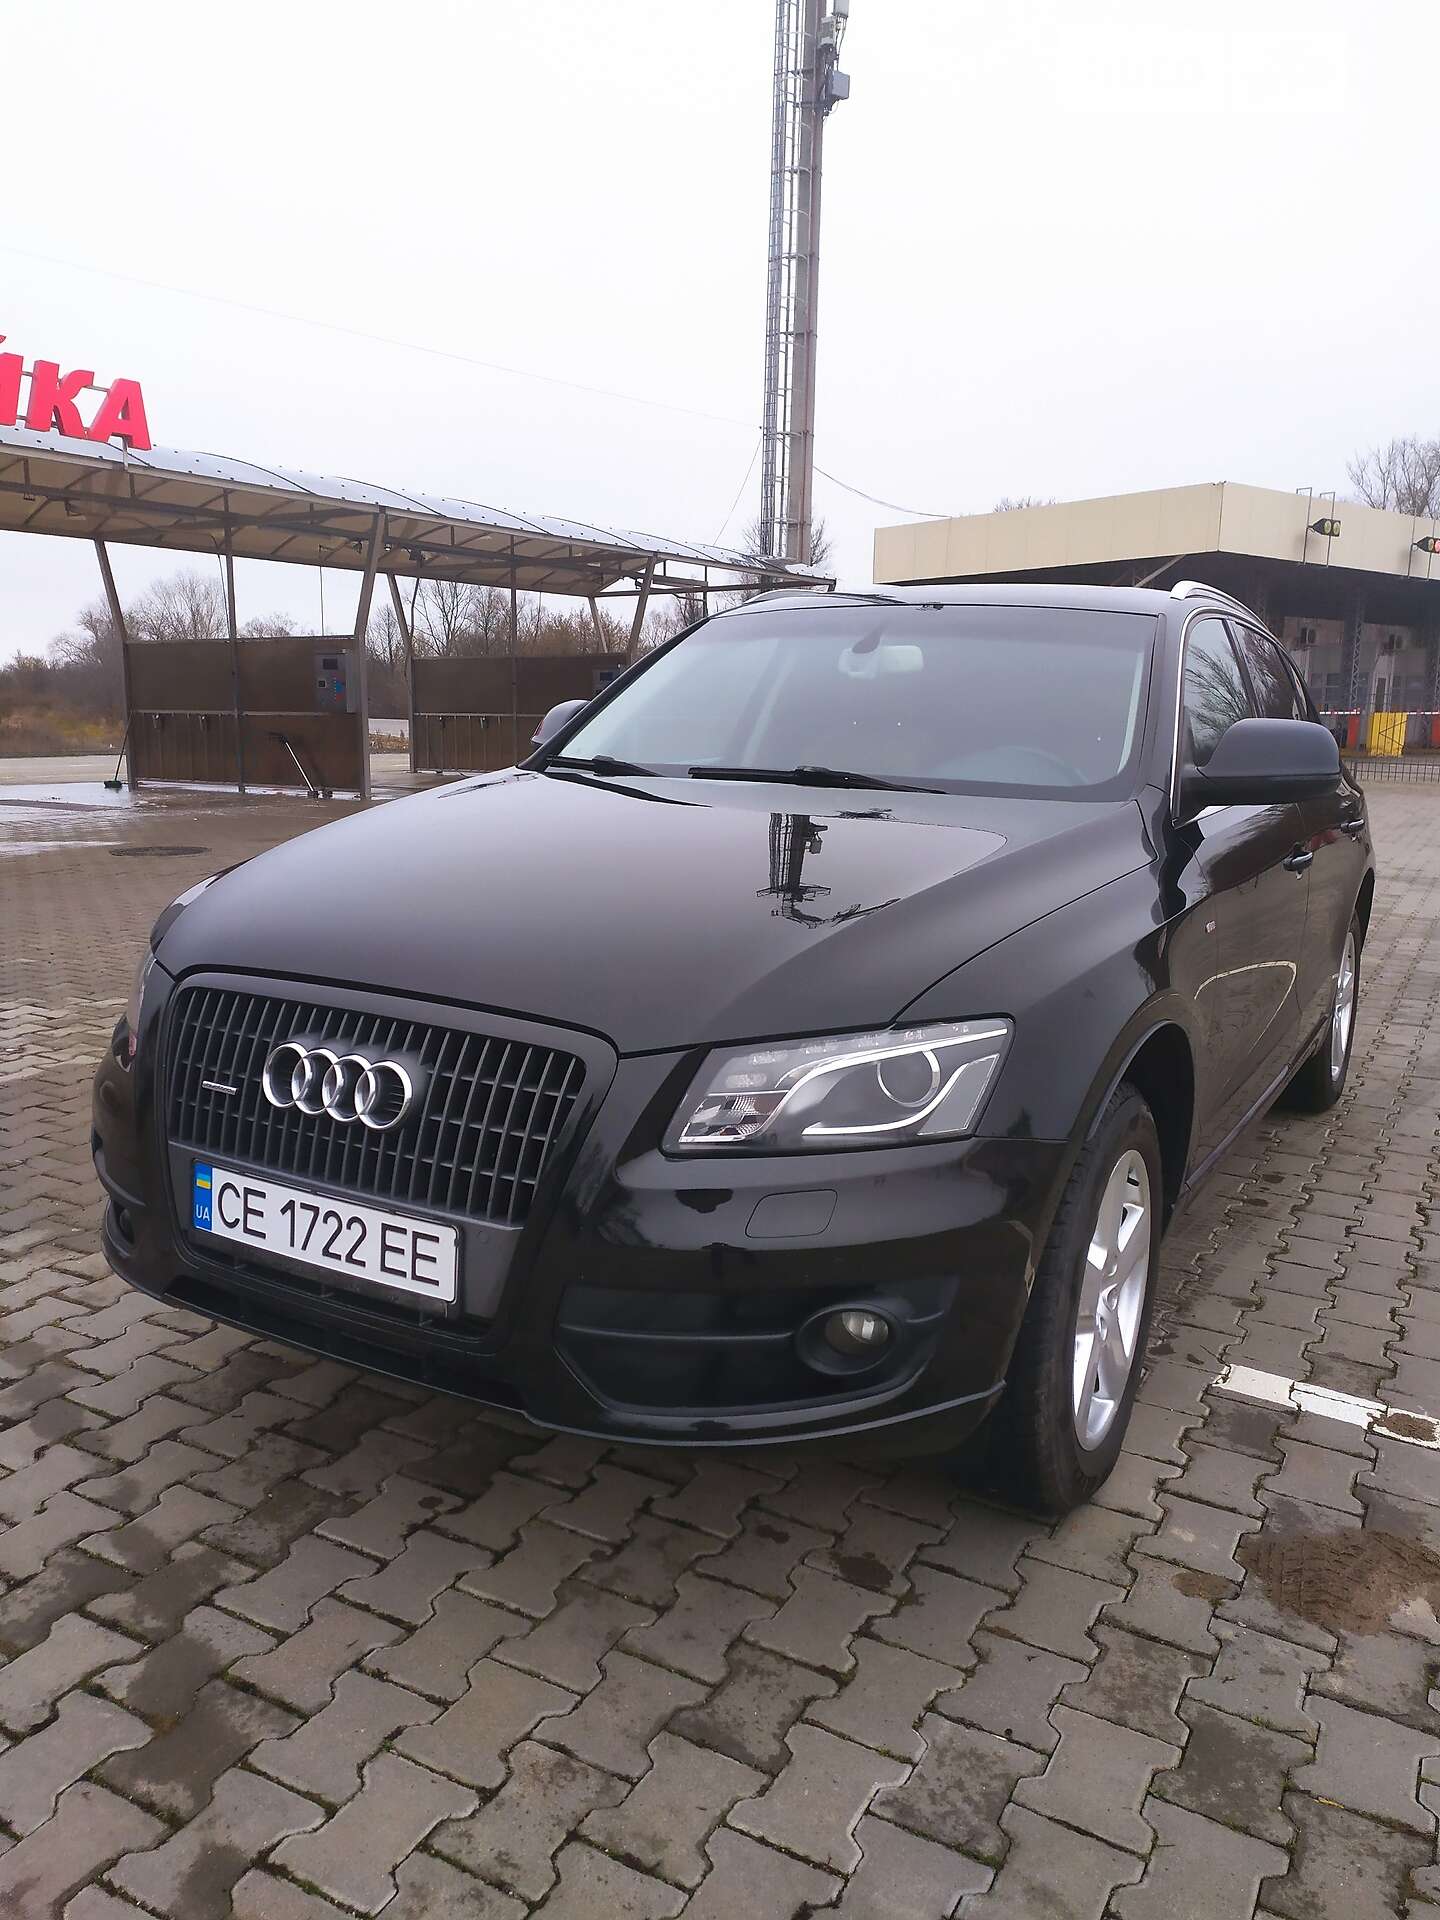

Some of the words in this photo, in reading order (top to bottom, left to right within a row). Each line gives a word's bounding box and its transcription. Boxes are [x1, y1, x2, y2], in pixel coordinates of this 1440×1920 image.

[195, 1204, 210, 1222] UA
[217, 1181, 267, 1239] CE
[280, 1199, 367, 1268] 1722
[380, 1222, 440, 1287] EE
